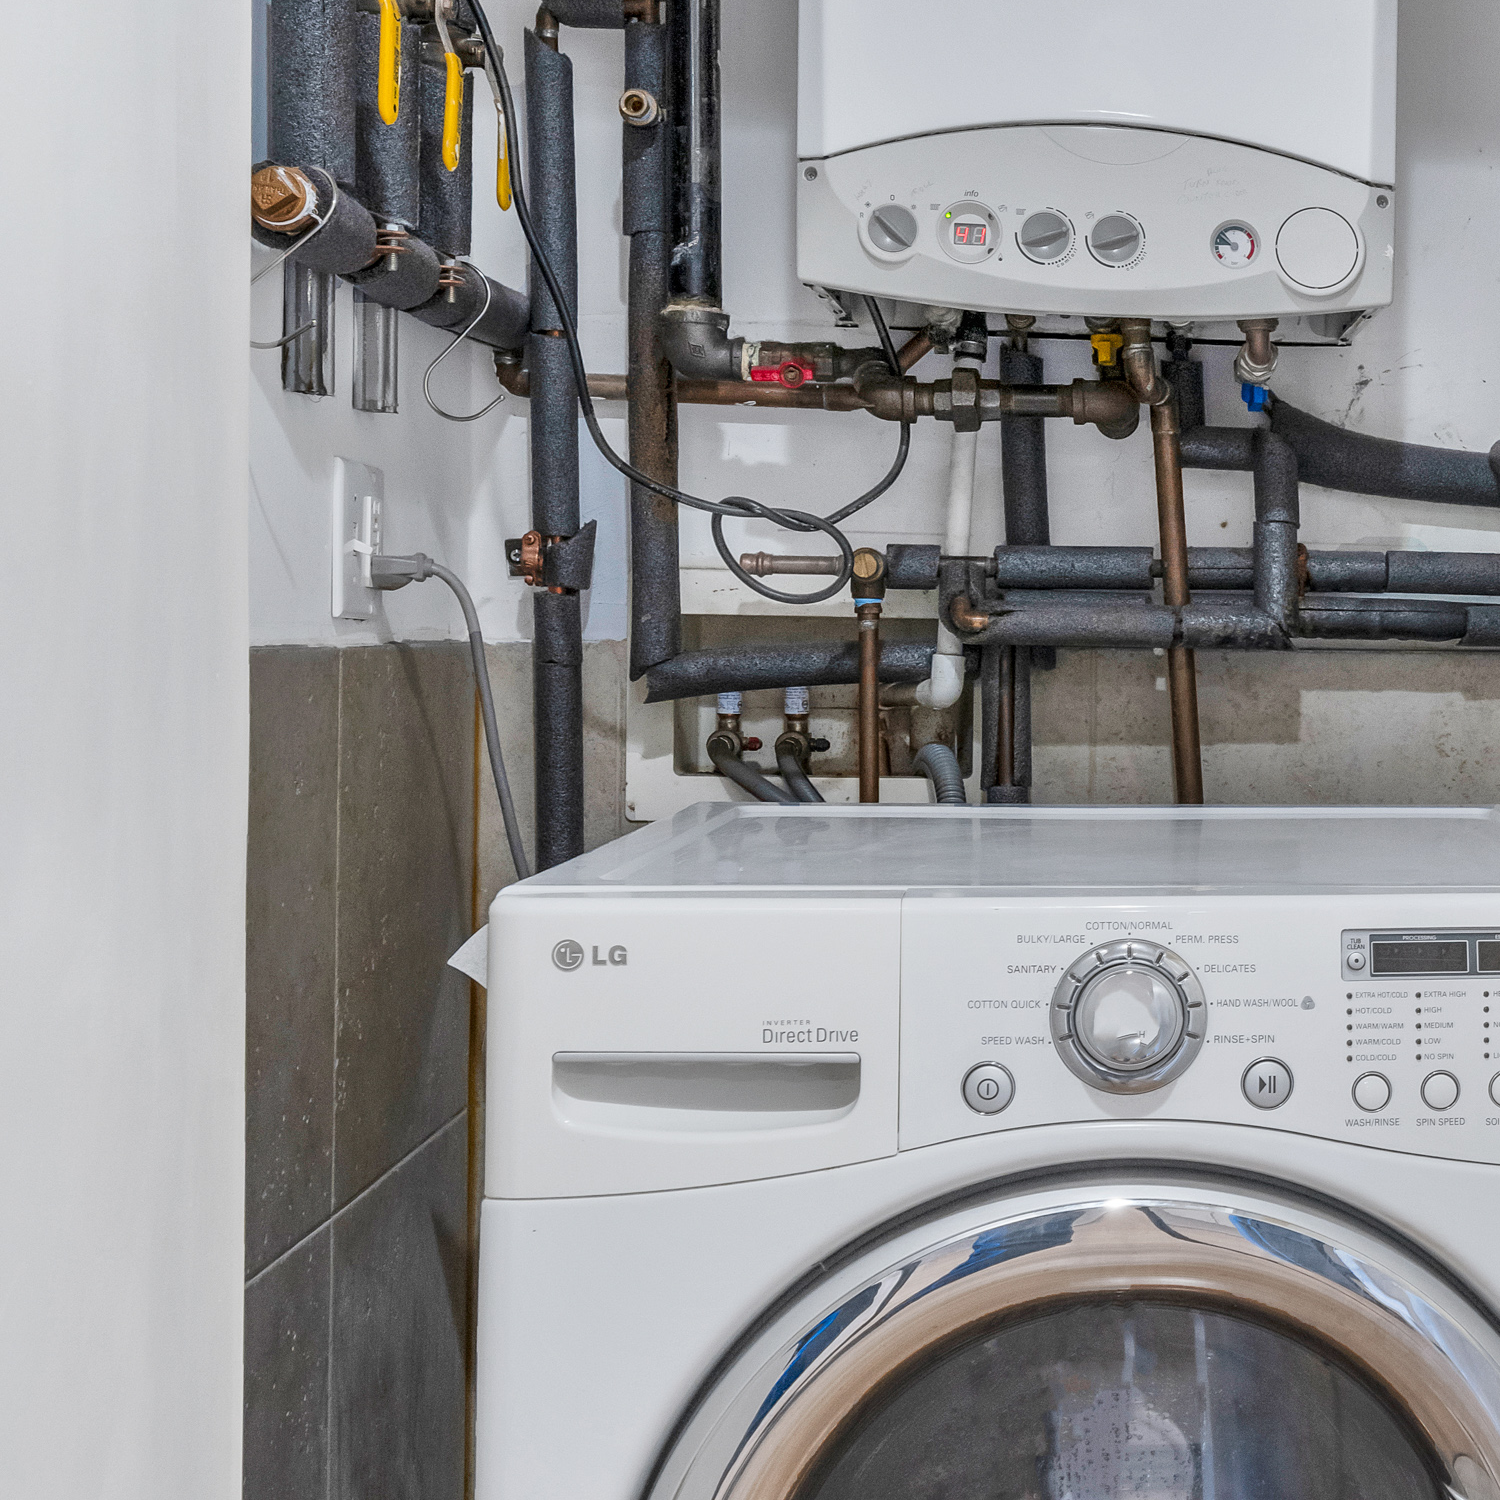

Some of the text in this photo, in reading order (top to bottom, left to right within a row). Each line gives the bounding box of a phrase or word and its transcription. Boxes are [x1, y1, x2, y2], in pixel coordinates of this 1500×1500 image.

[956, 226, 986, 244] 41
[1085, 921, 1173, 931] COTTON/NORMAL
[1016, 934, 1086, 944] BULKY/LARGE
[1175, 935, 1239, 944] PERM. PRESS
[592, 945, 627, 966] LG
[1006, 965, 1057, 974] SANITARY
[1203, 964, 1256, 973] DELICATES
[1449, 990, 1466, 998] HIGH
[967, 1000, 1041, 1009] COTTON QUICK
[1216, 998, 1299, 1007] HAND WASH/WOOL
[762, 1027, 859, 1043] Direct Drive
[1213, 1034, 1275, 1044] RINSE+SPIN
[981, 1036, 1045, 1045] SPEED WASH
[1344, 1118, 1400, 1127] WASH/RINSE
[1416, 1117, 1466, 1127] SPIN SPEED
